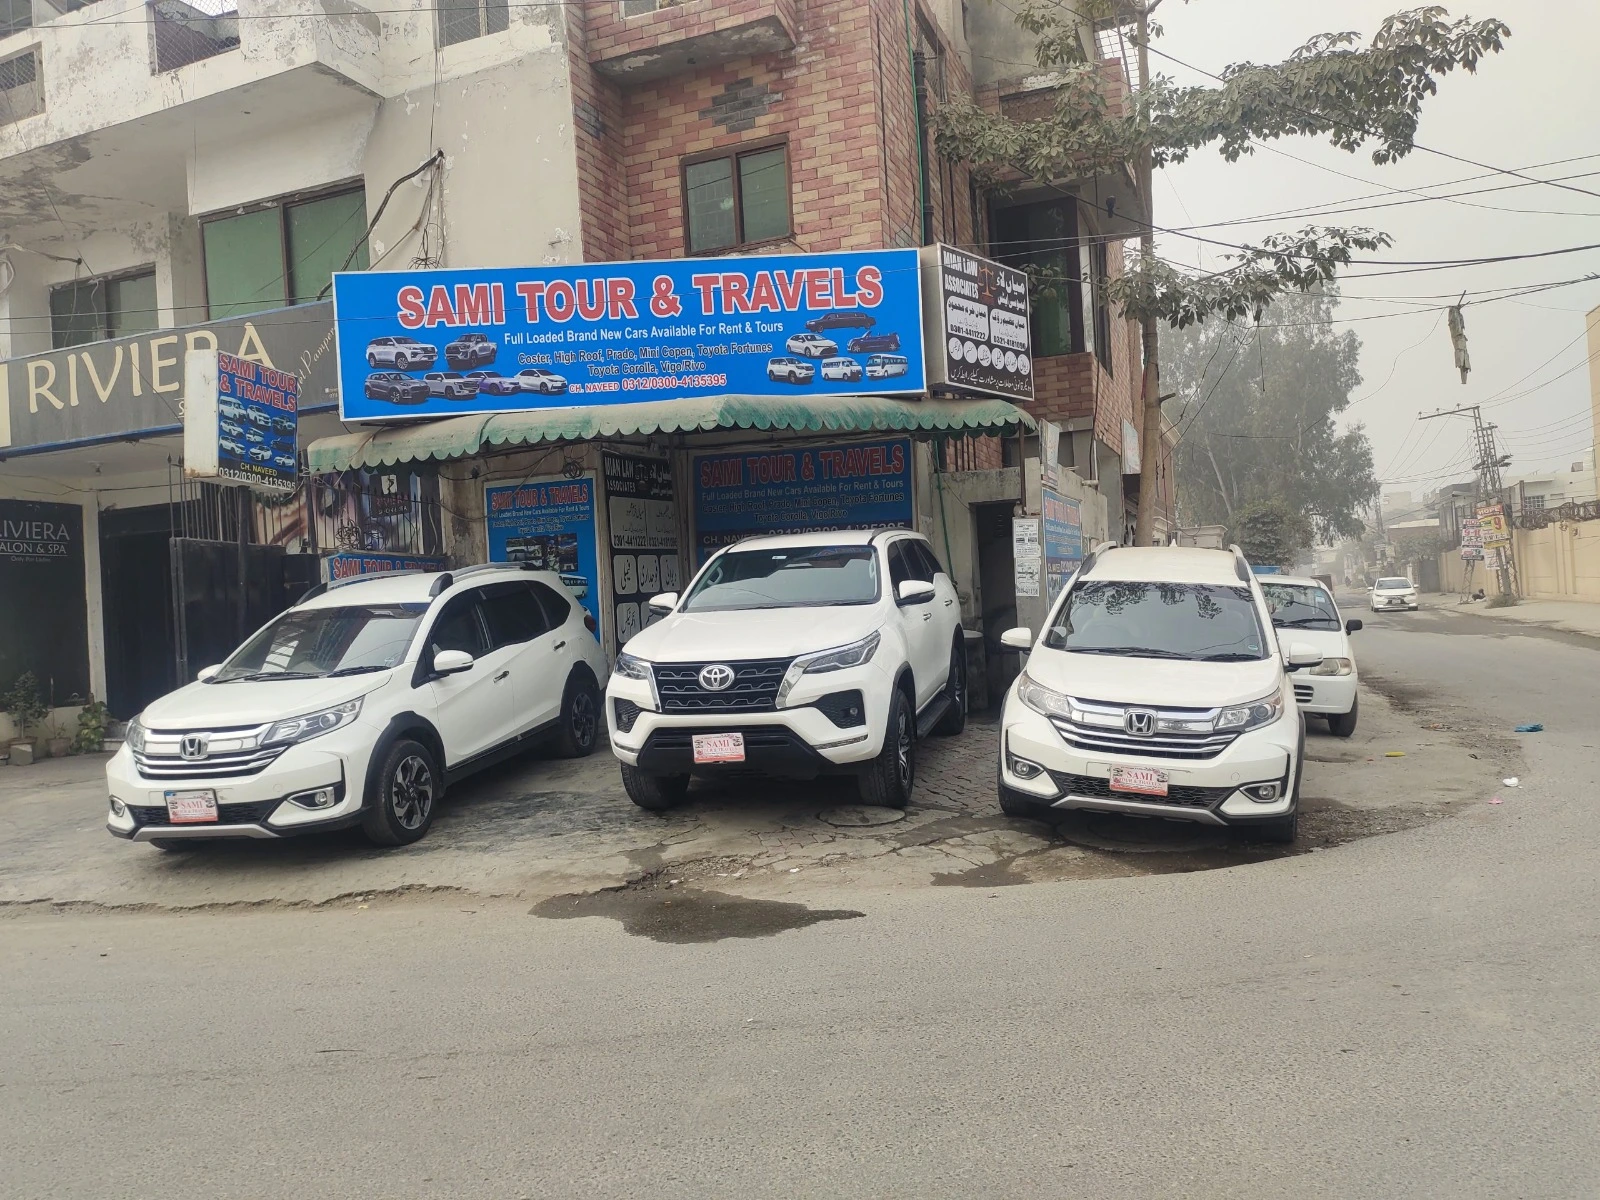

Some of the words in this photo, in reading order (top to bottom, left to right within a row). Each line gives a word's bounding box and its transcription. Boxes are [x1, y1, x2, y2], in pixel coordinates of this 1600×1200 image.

[943, 251, 962, 272] MIAN
[963, 257, 978, 277] LAW
[397, 282, 505, 329] SAMI
[516, 277, 639, 323] TOUR
[650, 274, 682, 318] &
[692, 265, 883, 315] TRAVELS
[945, 273, 978, 299] ASSOCIATES
[504, 332, 524, 345] Full
[526, 330, 564, 344] Loaded
[567, 328, 598, 342] Brand
[600, 328, 622, 341] New
[624, 327, 648, 340] Cars
[651, 323, 697, 338] Available
[699, 323, 717, 336] For
[719, 322, 743, 335] Rent
[745, 321, 753, 334] &
[755, 321, 784, 334] Tours
[518, 352, 552, 366] Coster,
[554, 351, 576, 365] High
[578, 349, 605, 363] Roof,
[606, 348, 638, 361] Prado,
[639, 347, 661, 359] Mini
[662, 346, 695, 360] Copen,
[697, 344, 729, 358] Toyota
[731, 343, 773, 355] Fortunes
[220, 354, 256, 381] SAMI
[260, 367, 296, 394] TOUR
[588, 364, 621, 377] Toyota
[622, 363, 658, 376] Corolla,
[660, 361, 706, 374] Vigo/Rivo
[220, 374, 231, 393] &
[235, 379, 296, 412] TRAVELS
[568, 384, 584, 394] CH.
[585, 382, 619, 393] NAVEED
[621, 374, 727, 391] 0312/0300-4135395
[240, 463, 252, 472] CH.
[253, 464, 277, 476] NAVEED
[701, 458, 742, 489] SAMI
[746, 454, 797, 485] TOUR
[801, 452, 815, 481] &
[819, 444, 904, 479] TRAVELS
[219, 467, 296, 490] 0312/0300-4135395
[514, 488, 538, 508] TOUR
[540, 488, 547, 506] &
[549, 484, 589, 505] TRAVELS
[702, 492, 715, 501] Full
[716, 491, 742, 500] Loaded
[744, 490, 765, 498] Brand
[767, 488, 783, 496] New
[784, 487, 801, 495] Cars
[803, 484, 837, 493] Available
[839, 483, 852, 491] For
[854, 481, 872, 491] Rent
[873, 480, 879, 489] &
[881, 479, 904, 488] Tours
[868, 491, 905, 503] Fortunes
[0, 520, 70, 540] IVIERA
[703, 535, 720, 544] CH.
[0, 542, 32, 553] ALON
[36, 543, 45, 554] &
[48, 544, 67, 554] SPA
[333, 557, 361, 580] SAMI
[706, 739, 730, 748] SAMI
[1126, 770, 1153, 781] SAMI
[181, 800, 203, 809] SAMI
